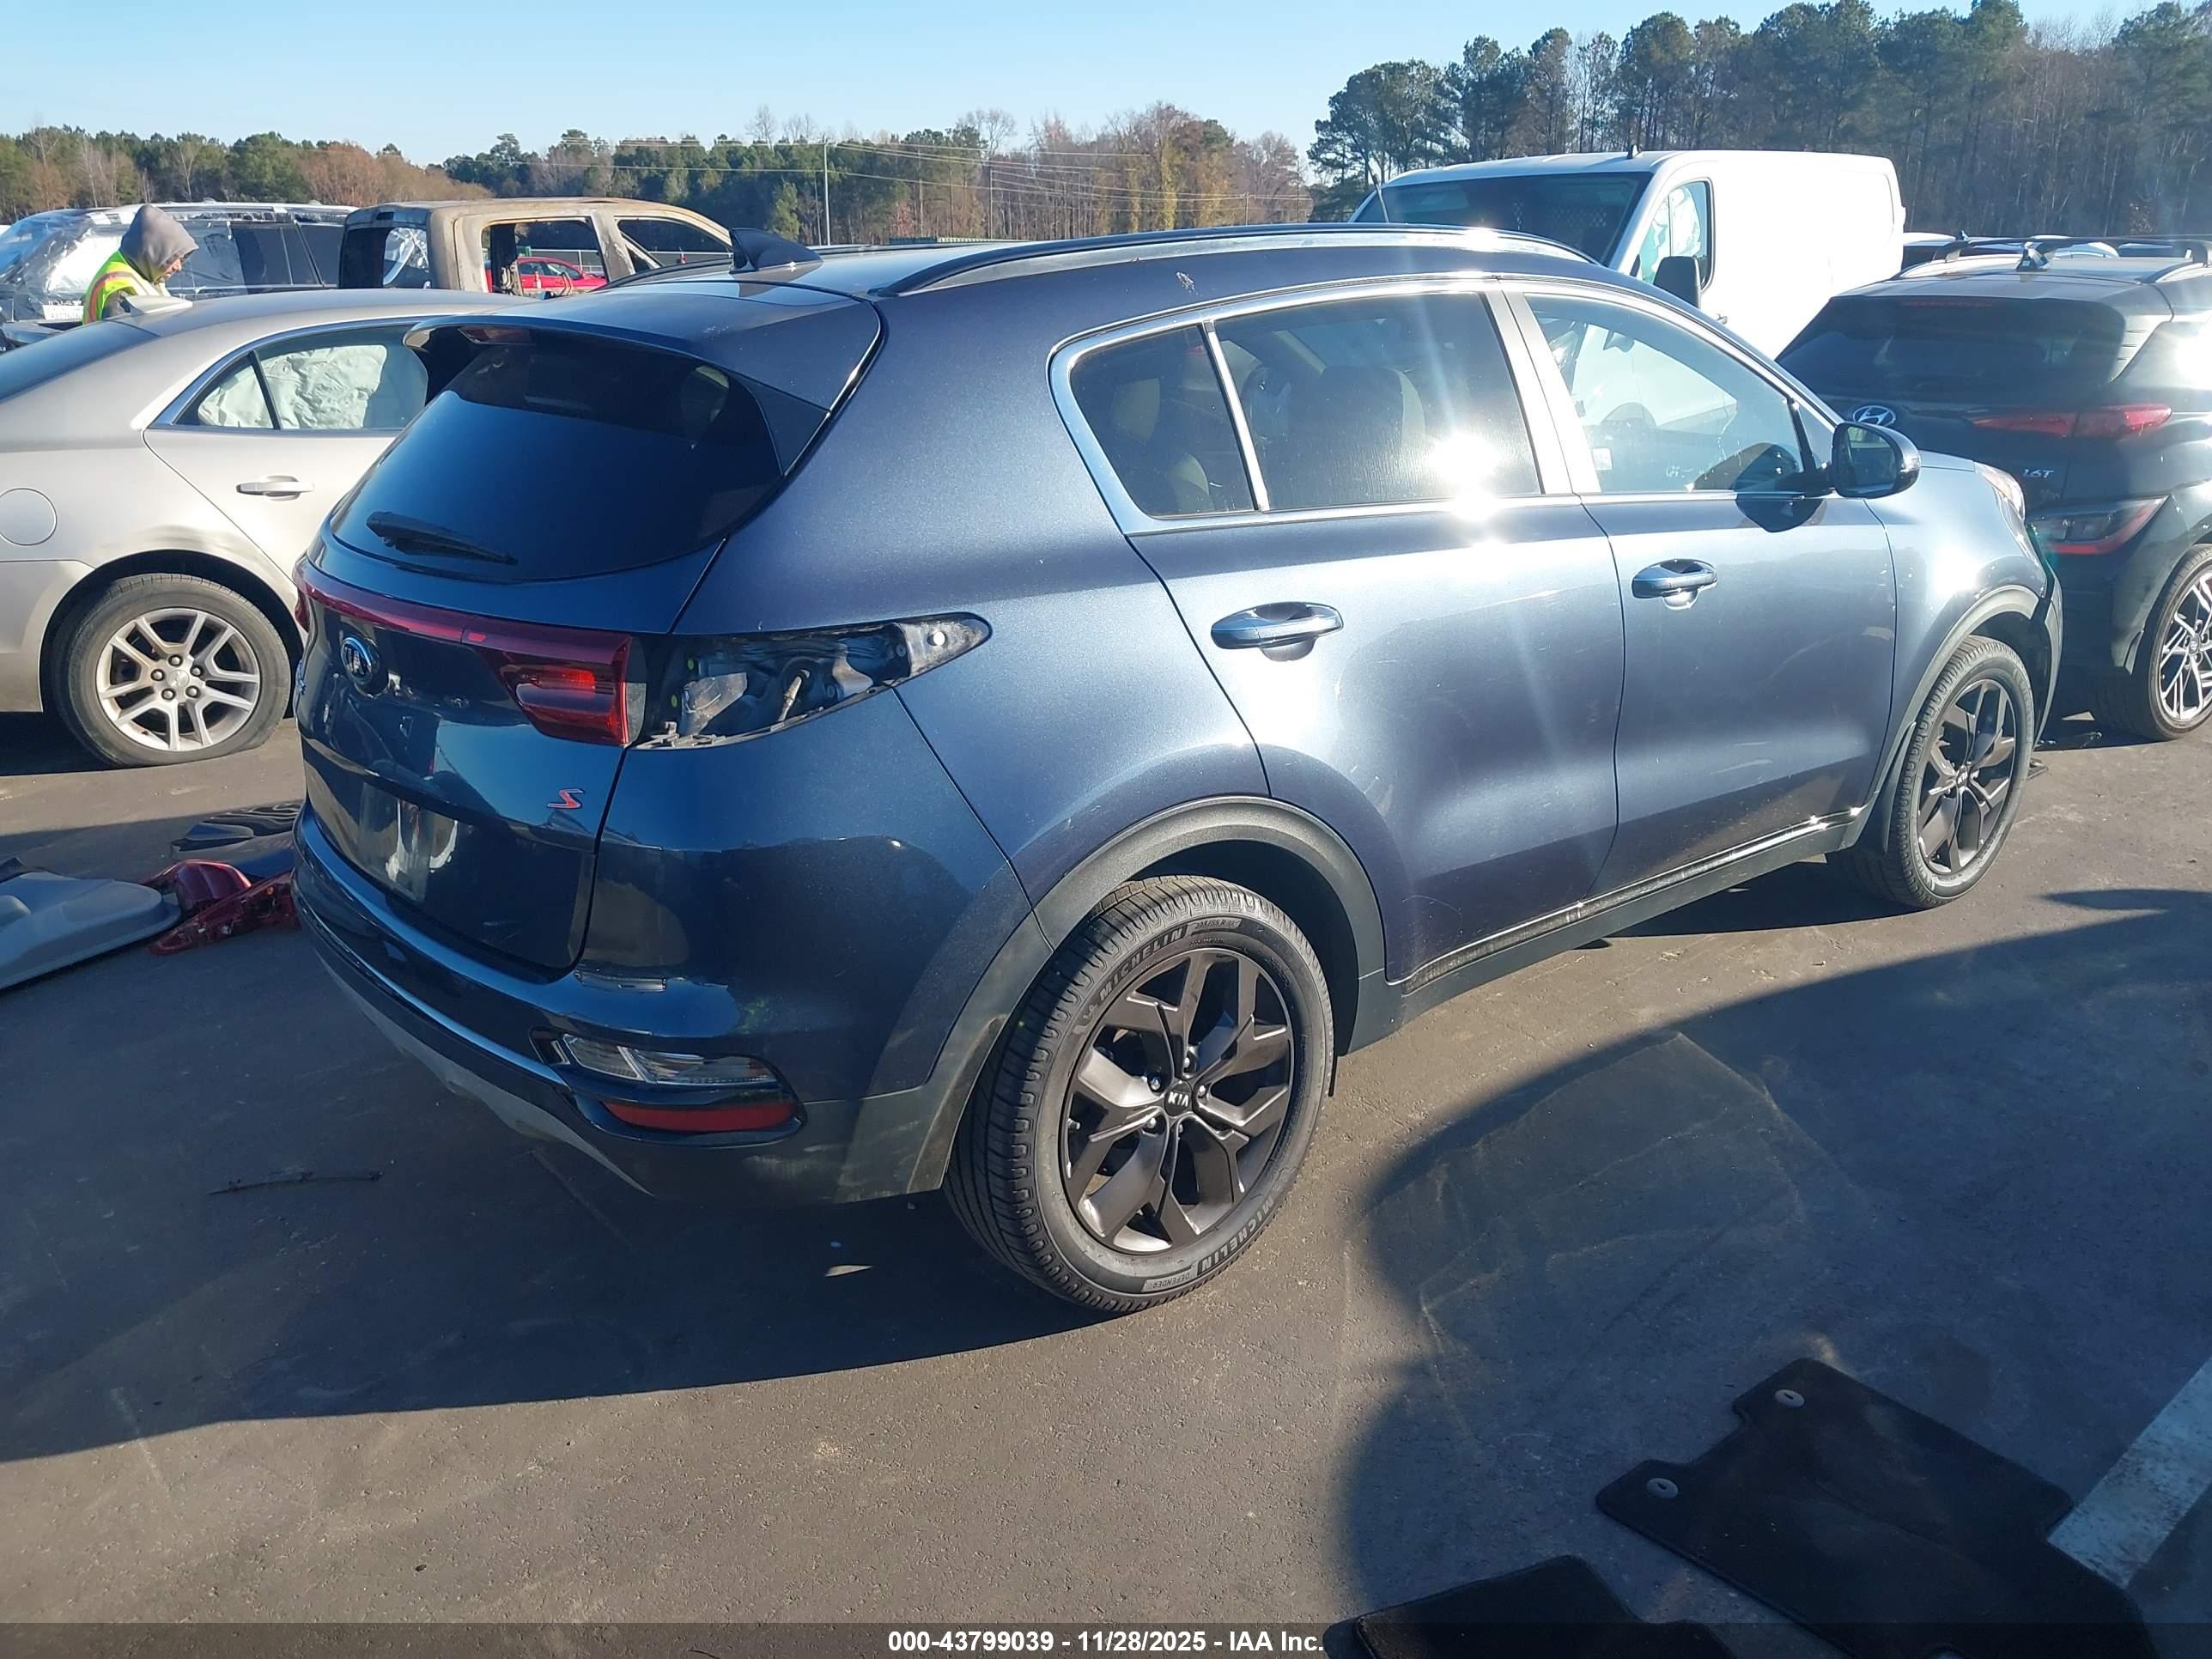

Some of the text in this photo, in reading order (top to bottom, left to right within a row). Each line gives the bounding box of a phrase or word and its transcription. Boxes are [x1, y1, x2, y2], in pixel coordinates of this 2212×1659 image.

[547, 787, 586, 810] S
[1099, 926, 1182, 1001] MICHELIN
[1168, 1091, 1190, 1108] KIA
[1152, 1195, 1274, 1289] MICHELIN DEFENDER
